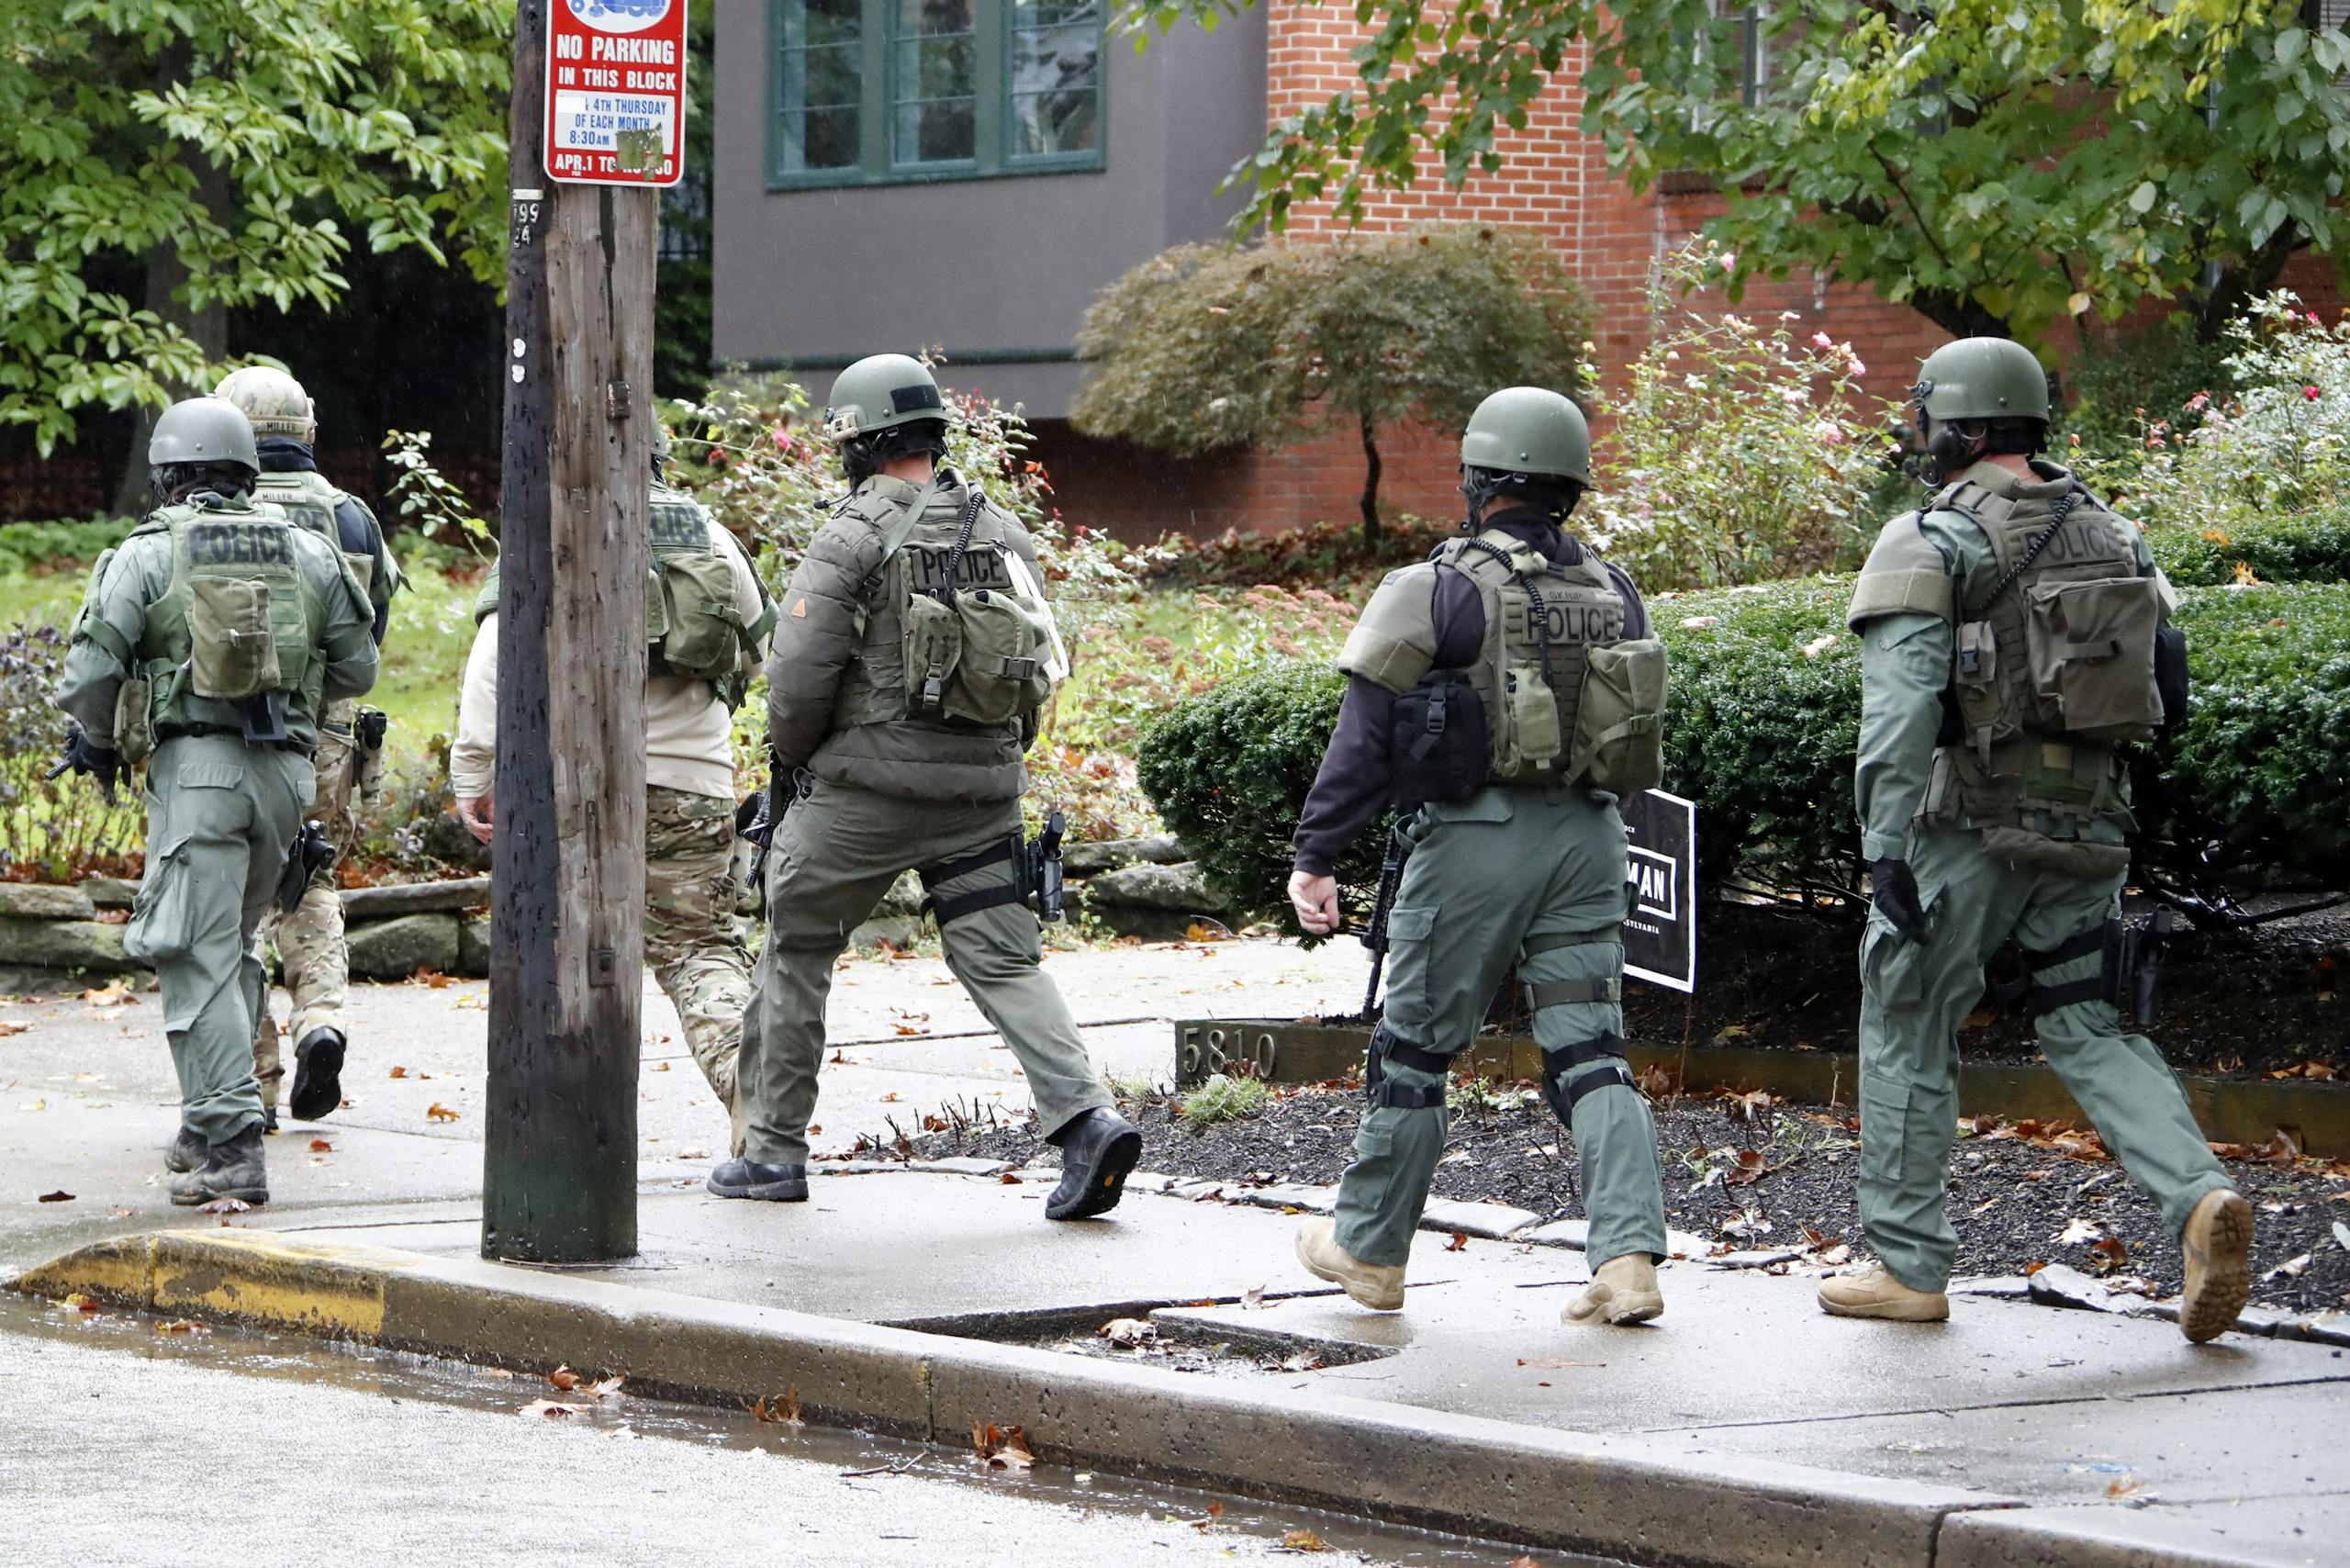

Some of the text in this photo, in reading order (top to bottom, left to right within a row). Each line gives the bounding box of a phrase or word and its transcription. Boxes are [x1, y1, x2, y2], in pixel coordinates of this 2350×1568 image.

[556, 34, 675, 65] NO PARKING
[558, 66, 677, 91] IN THIS BLOCK
[593, 97, 611, 112] 4TH
[615, 98, 667, 116] THURSDAY
[575, 114, 650, 131] OF EACH MONTH
[569, 130, 610, 145] 8:30AM
[267, 422, 296, 432] MILLER
[263, 493, 293, 501] MILLER
[189, 524, 295, 565] POLICE
[2024, 522, 2122, 561] POLICE
[1527, 606, 1616, 642] POLICE
[1623, 919, 1660, 935] SYLVANIA
[1183, 1027, 1275, 1079] 5810
